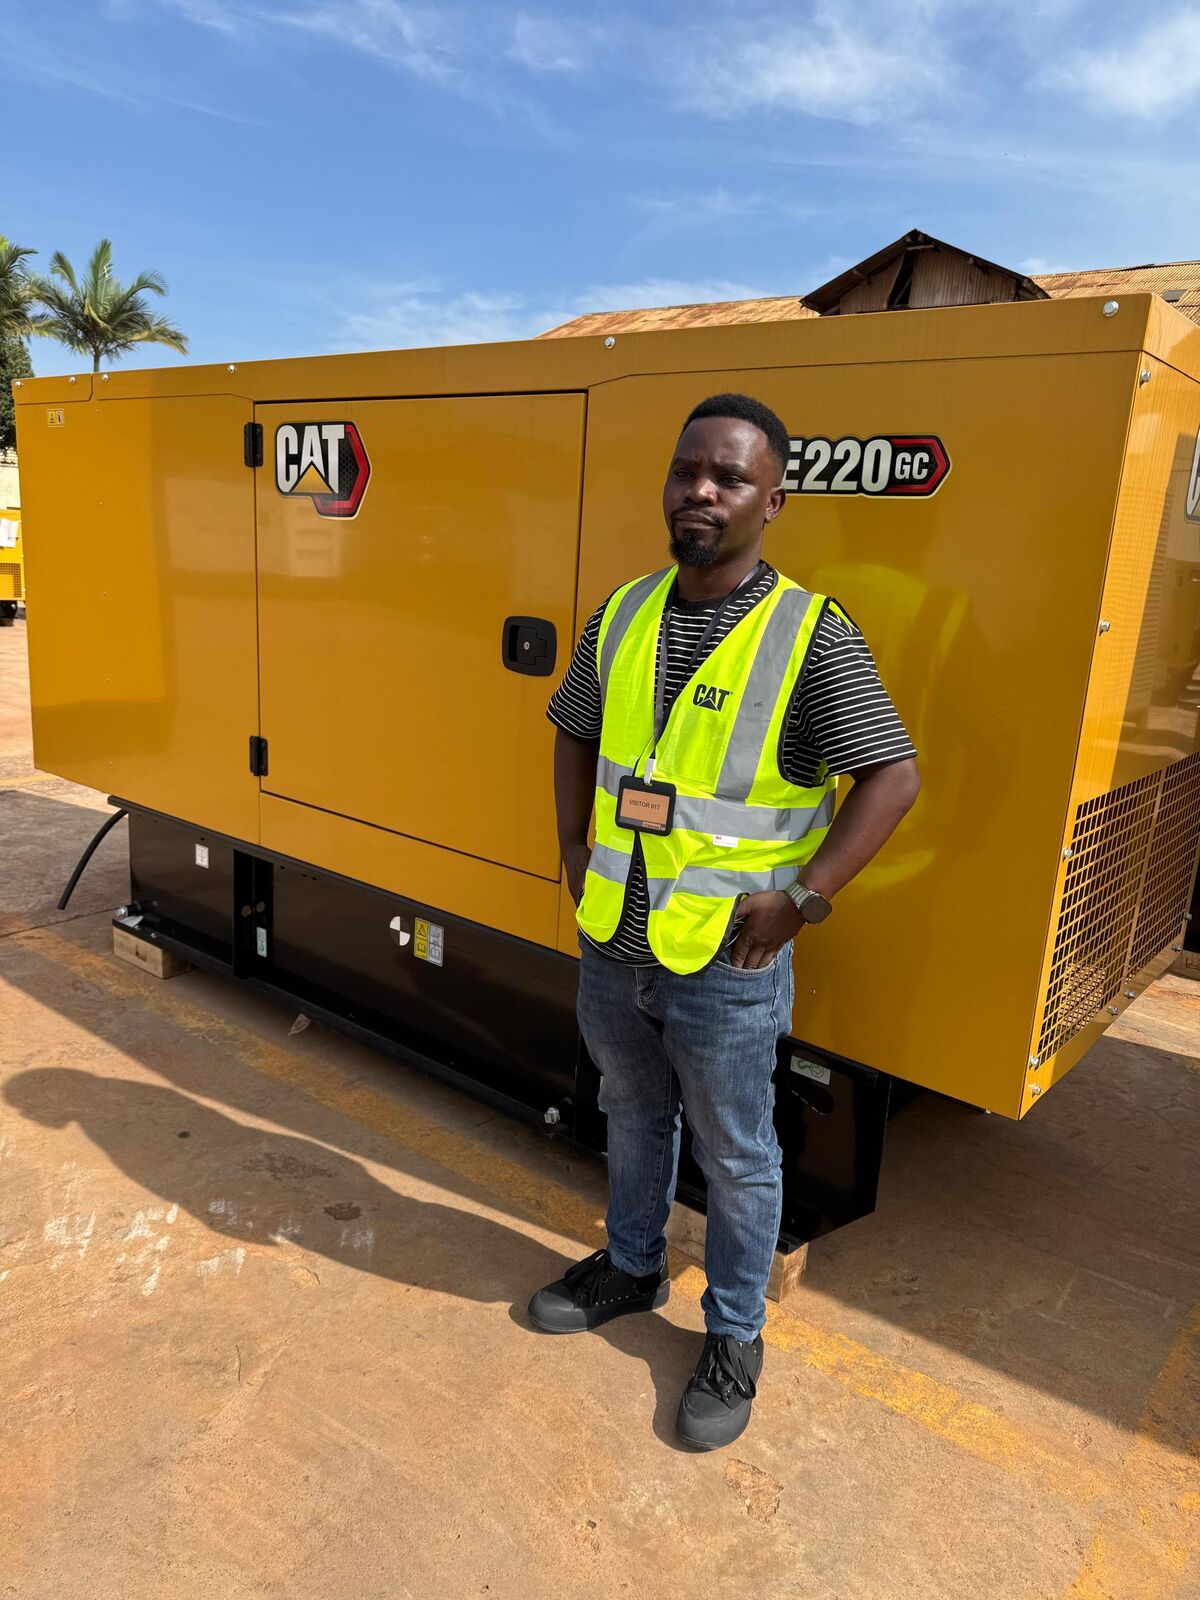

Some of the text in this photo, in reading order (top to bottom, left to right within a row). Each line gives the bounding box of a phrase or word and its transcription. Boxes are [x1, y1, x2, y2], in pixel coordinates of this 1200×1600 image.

[276, 424, 345, 494] CAT
[780, 438, 930, 492] E220 GC
[692, 683, 731, 712] CAT
[629, 799, 661, 811] VISITOR 017
